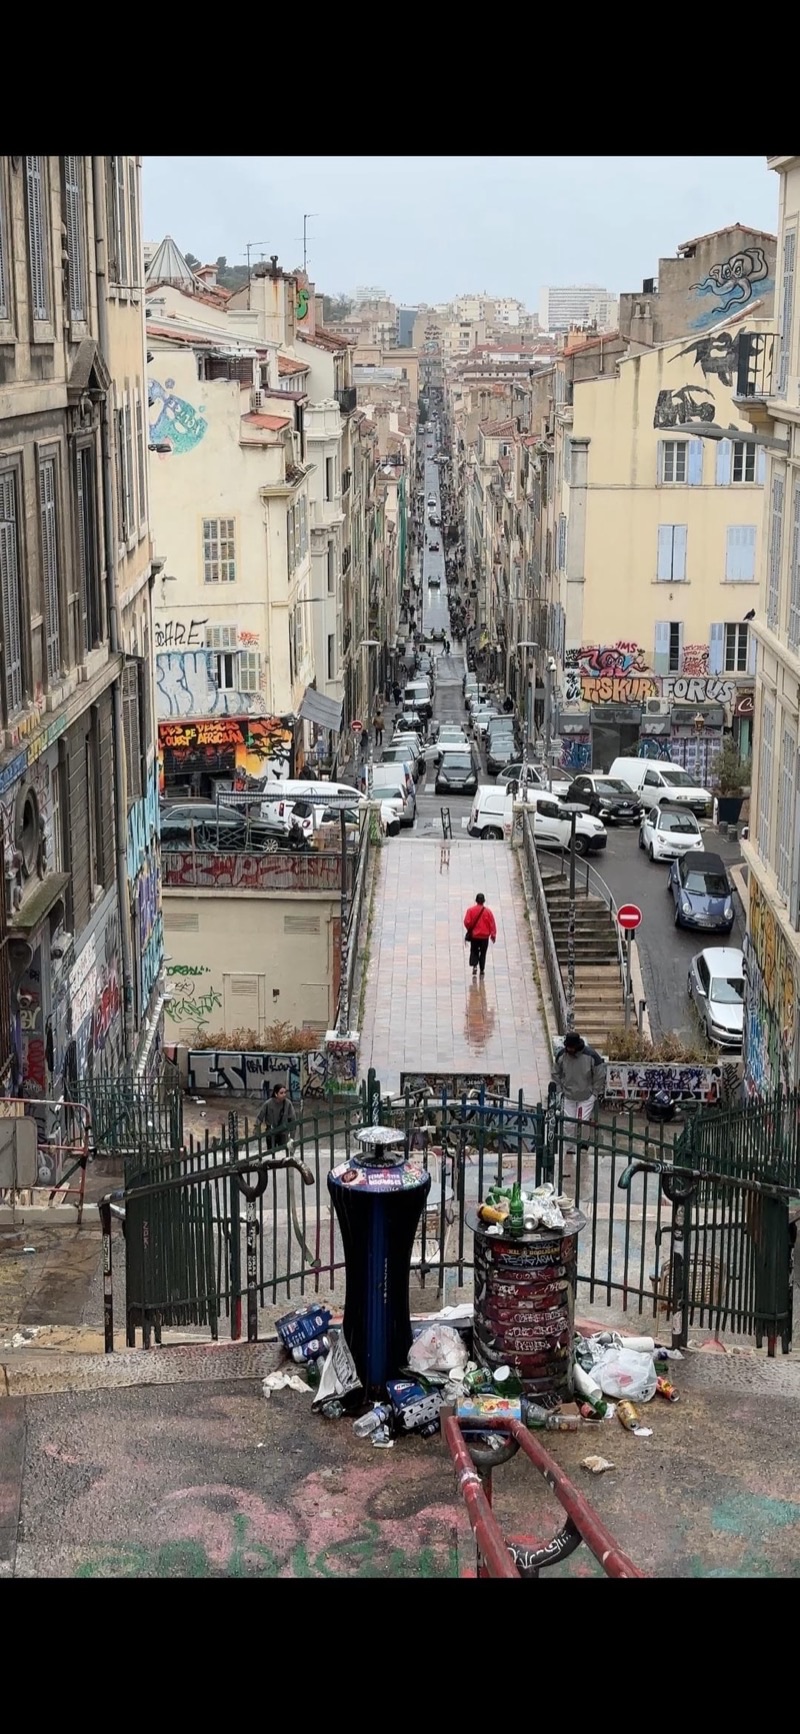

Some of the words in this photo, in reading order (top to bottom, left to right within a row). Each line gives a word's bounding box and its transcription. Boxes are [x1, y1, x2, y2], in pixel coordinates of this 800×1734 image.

[581, 677, 648, 704] TISKUR
[662, 677, 736, 703] FORUS
[159, 725, 183, 737] LES
[185, 728, 197, 738] DE
[197, 730, 245, 745] AFRICAIN
